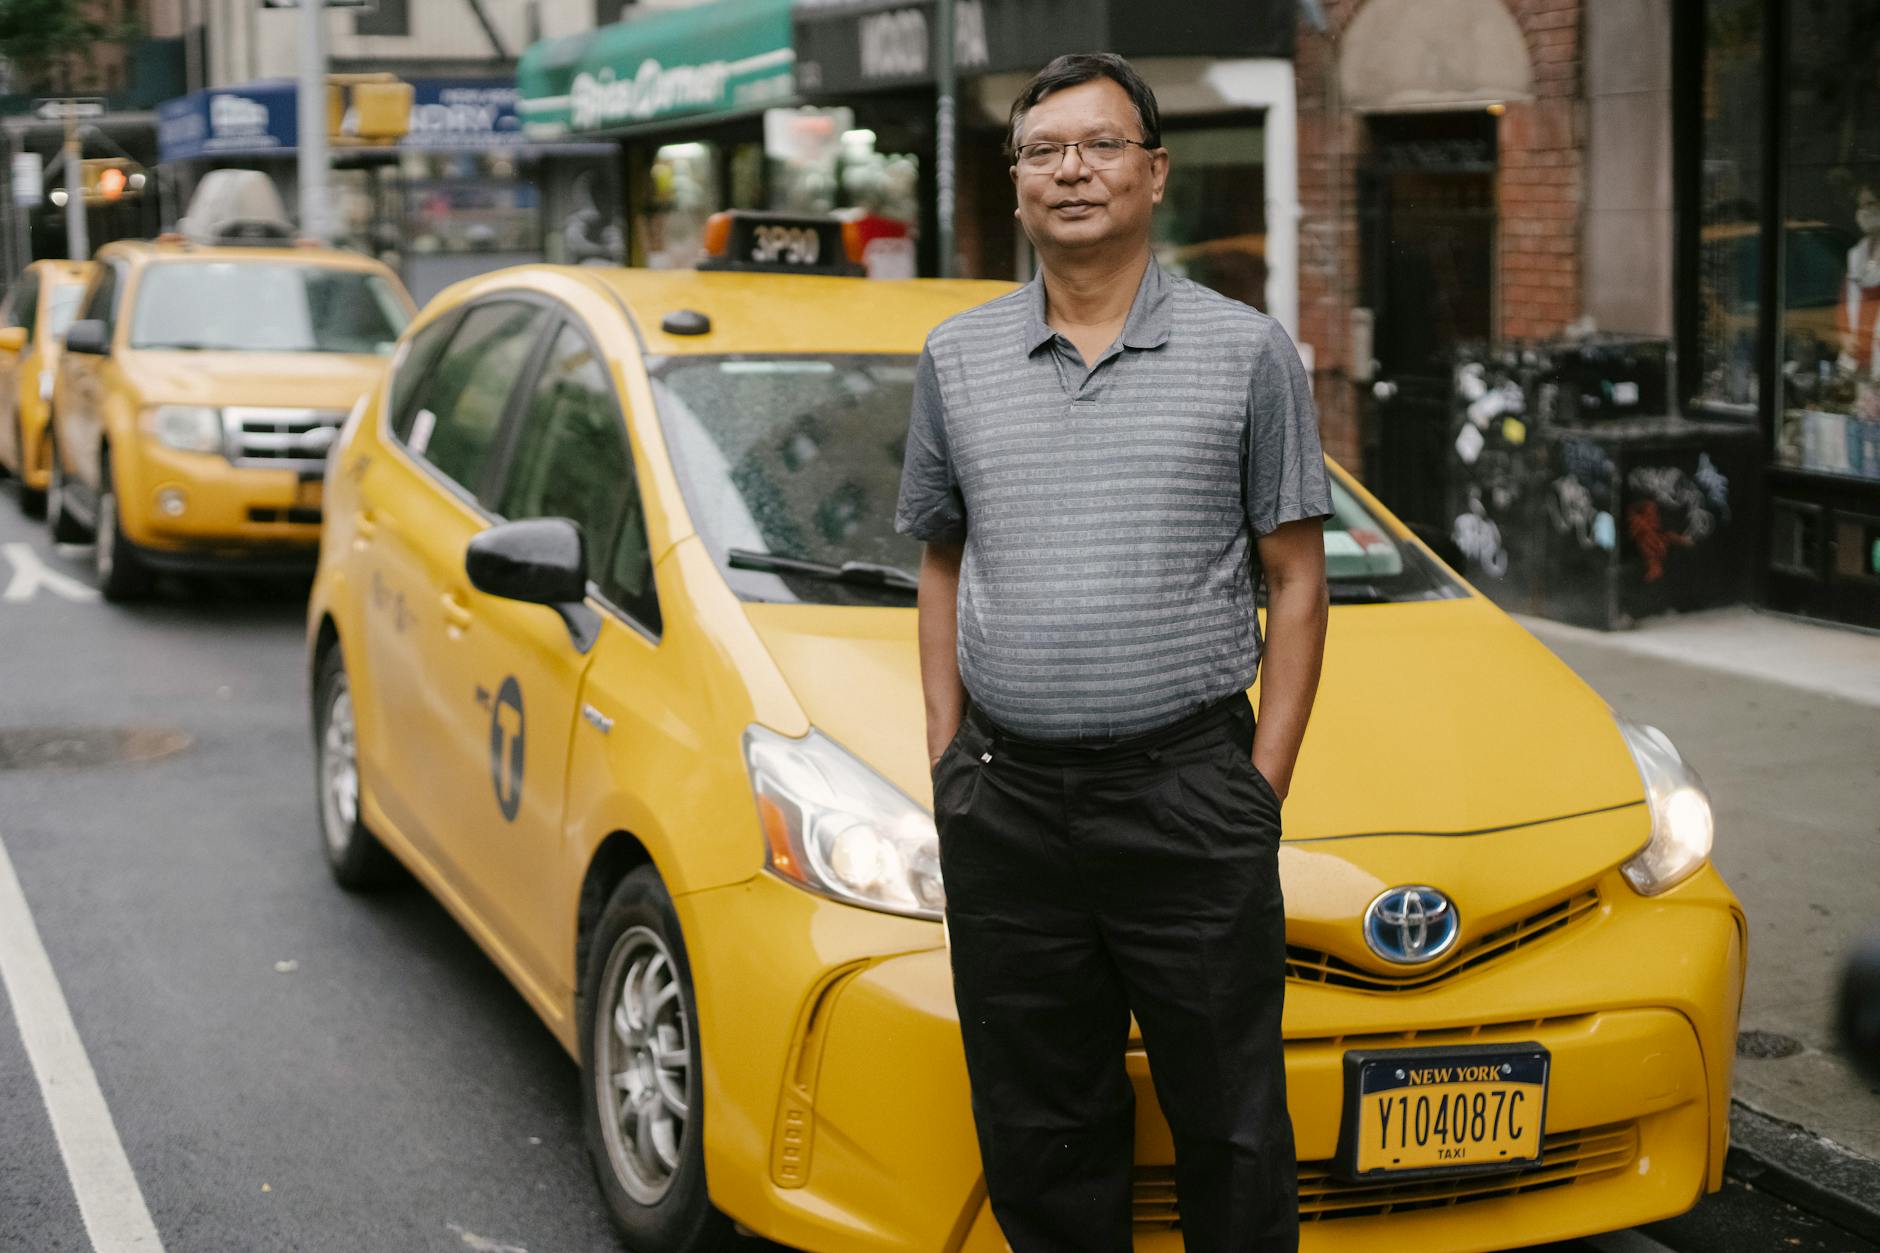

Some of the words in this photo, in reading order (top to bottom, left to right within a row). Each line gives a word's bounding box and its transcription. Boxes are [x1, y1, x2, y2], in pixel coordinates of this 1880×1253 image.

[632, 58, 729, 117] Corner
[1408, 1067, 1452, 1086] NEW
[1456, 1065, 1501, 1082] YORK
[1378, 1090, 1525, 1149] Y104087C
[1437, 1147, 1466, 1160] TAXI
